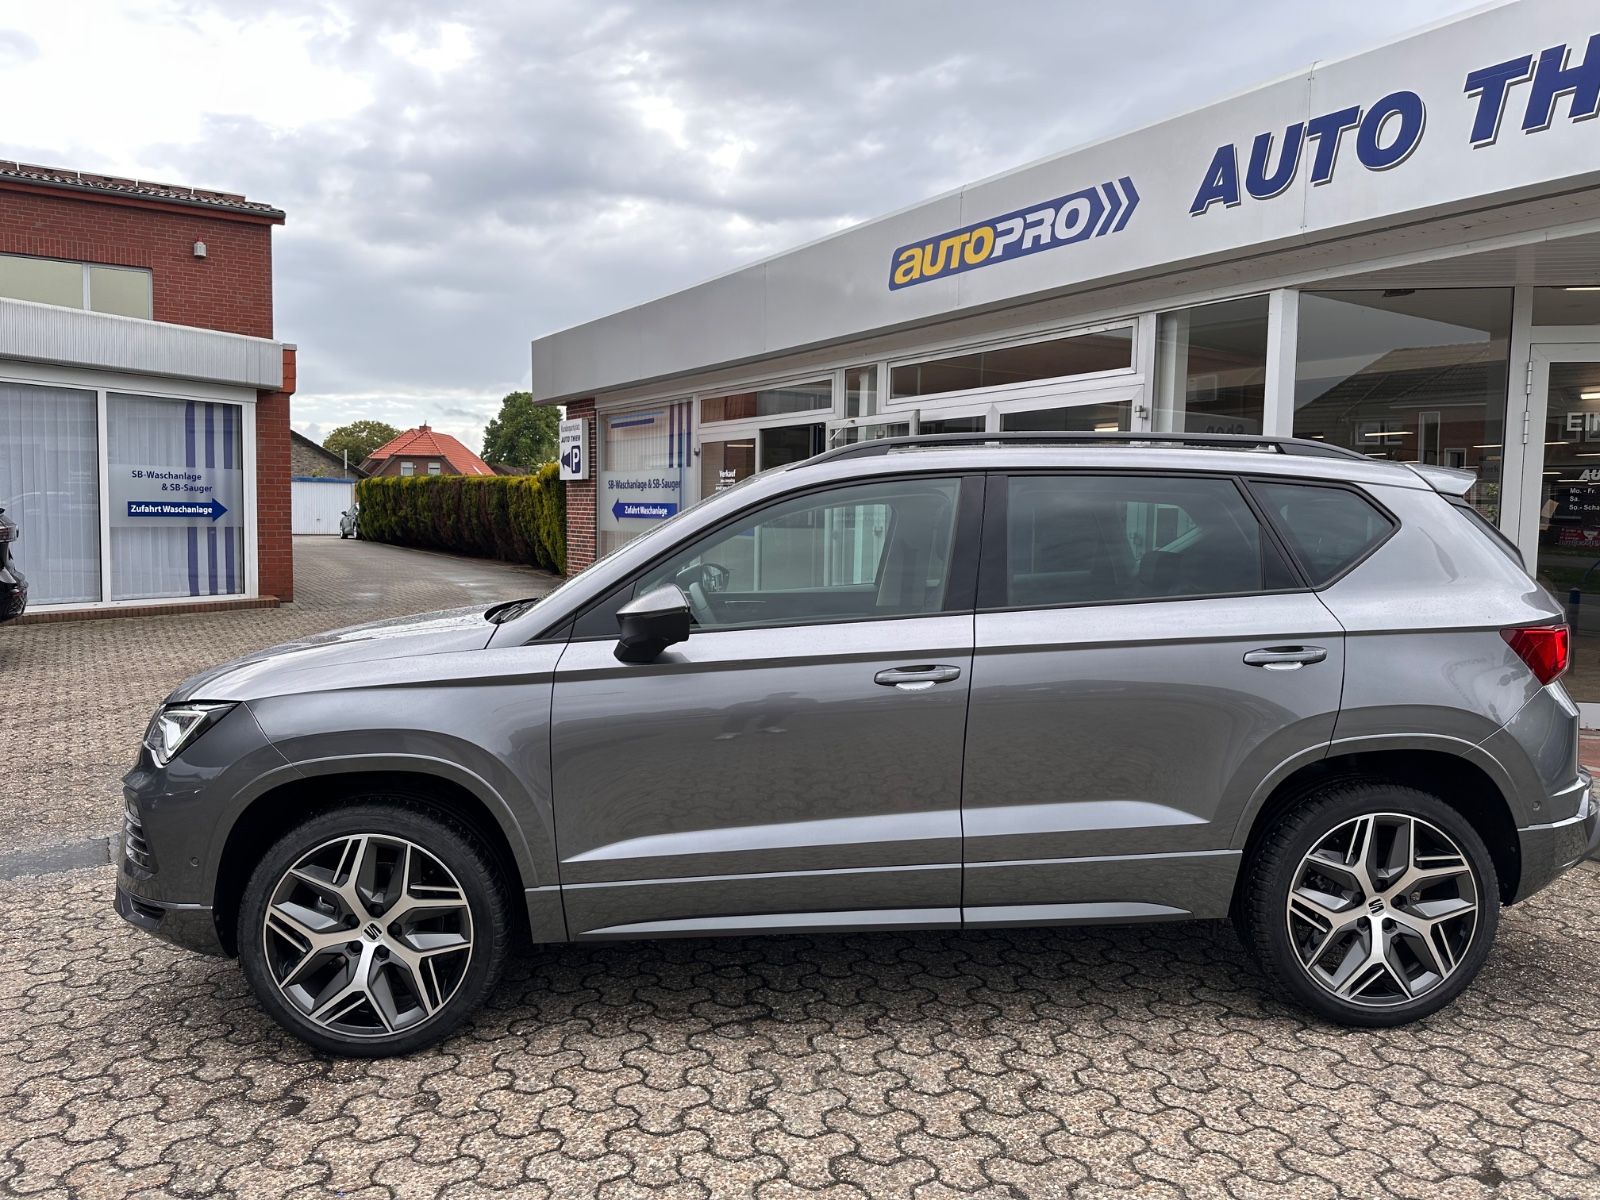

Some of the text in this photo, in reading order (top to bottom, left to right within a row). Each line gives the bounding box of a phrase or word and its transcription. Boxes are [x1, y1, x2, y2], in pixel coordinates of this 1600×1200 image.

[1188, 90, 1426, 218] AUTO
[131, 470, 202, 482] SB-Waschanlage
[161, 482, 213, 494] & SB-Sauger
[607, 479, 647, 491] SB-Waschanlage
[647, 478, 653, 489] &
[130, 504, 213, 515] Zufahrt Waschanlage
[624, 505, 668, 517] Zufahrt Waschanlage
